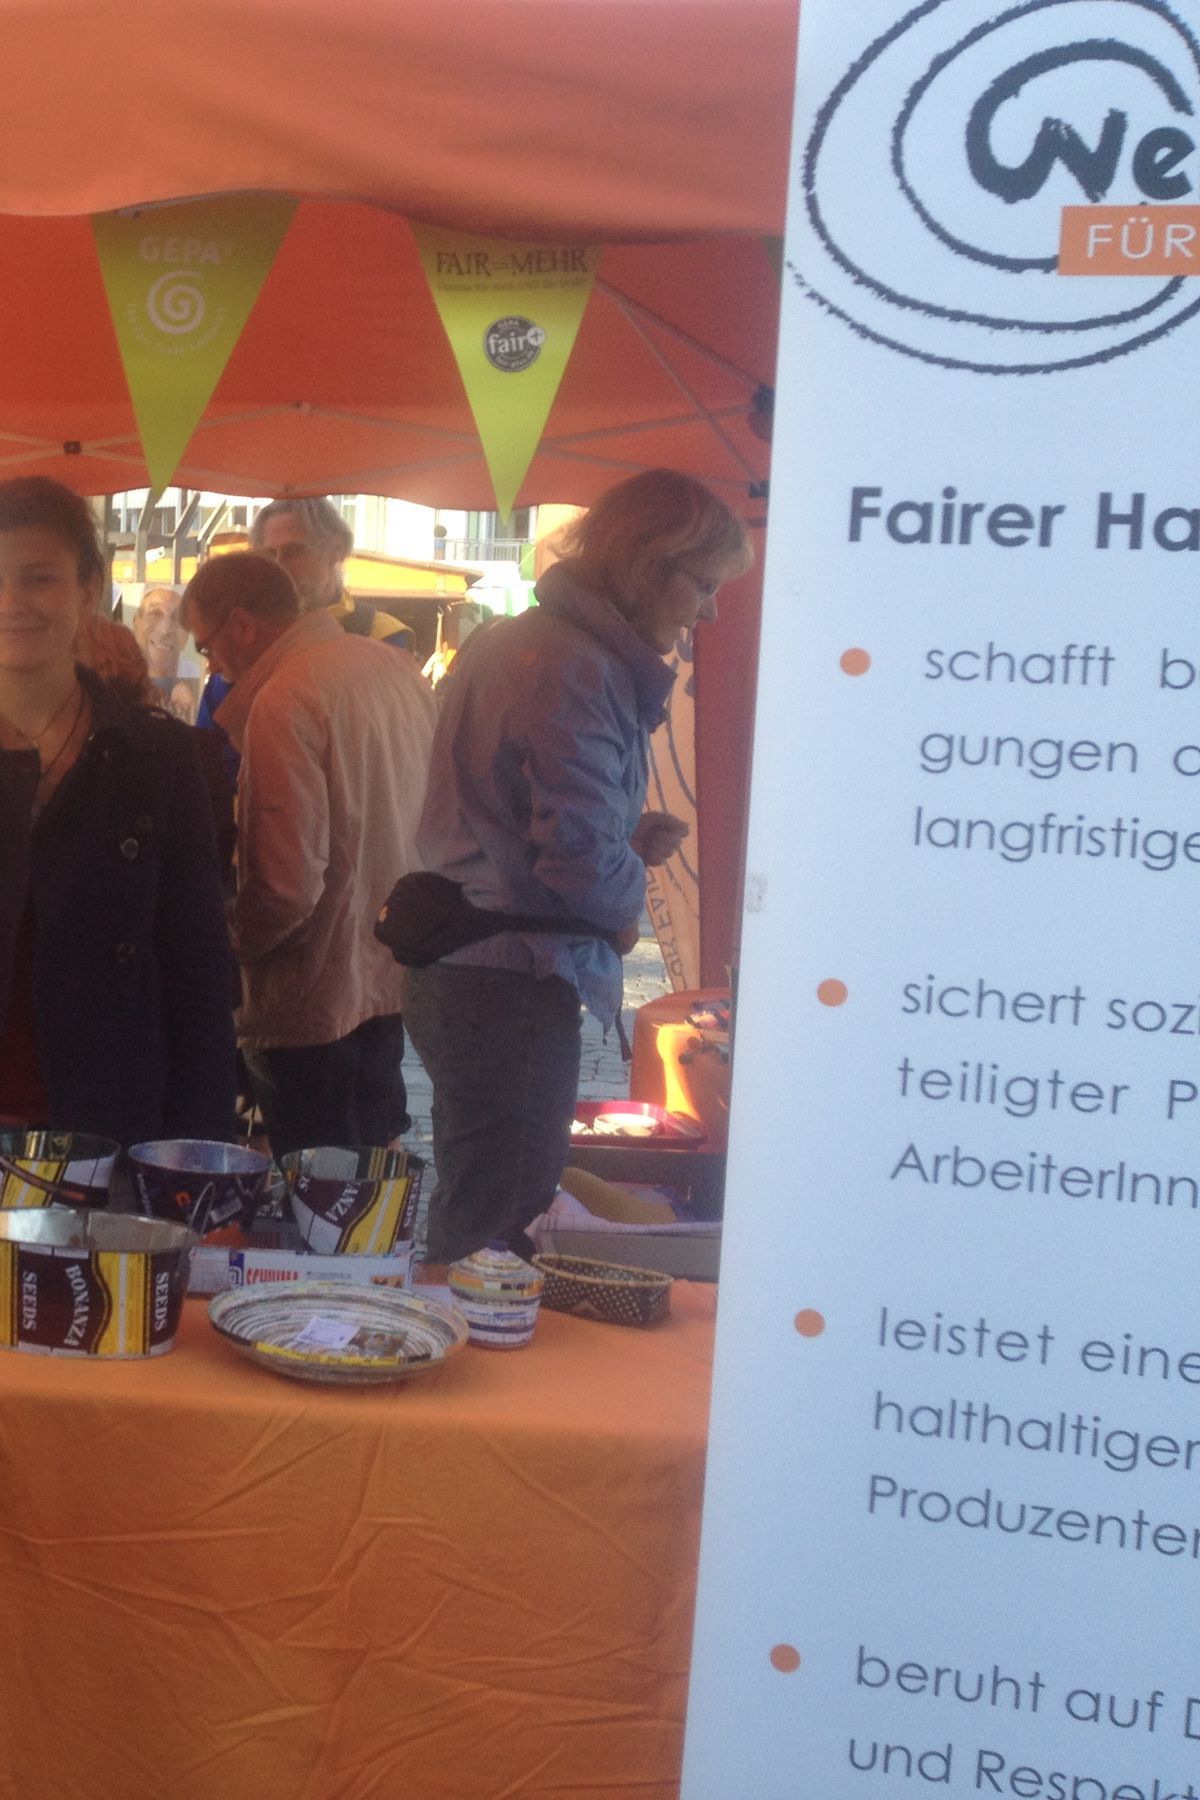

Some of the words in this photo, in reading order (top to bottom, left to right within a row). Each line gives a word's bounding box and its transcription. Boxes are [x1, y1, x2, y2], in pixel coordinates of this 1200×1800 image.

[847, 485, 1065, 549] Fairer
[924, 641, 1116, 688] schafft
[919, 732, 1139, 779] gungen
[913, 806, 1200, 872] langfristige
[901, 974, 1086, 1027] sichert
[1106, 998, 1200, 1036] soz
[897, 1057, 1131, 1118] teiligter
[891, 1143, 1199, 1210] ArbeiterInn
[22, 1271, 38, 1331] SEEDS
[64, 1264, 90, 1346] BONANZA
[154, 1271, 169, 1332] SEEDS
[878, 1306, 1056, 1366] leistet
[1081, 1333, 1200, 1384] eine
[855, 1645, 1047, 1713] beruht
[1065, 1689, 1165, 1732] auf
[848, 1738, 953, 1785] und
